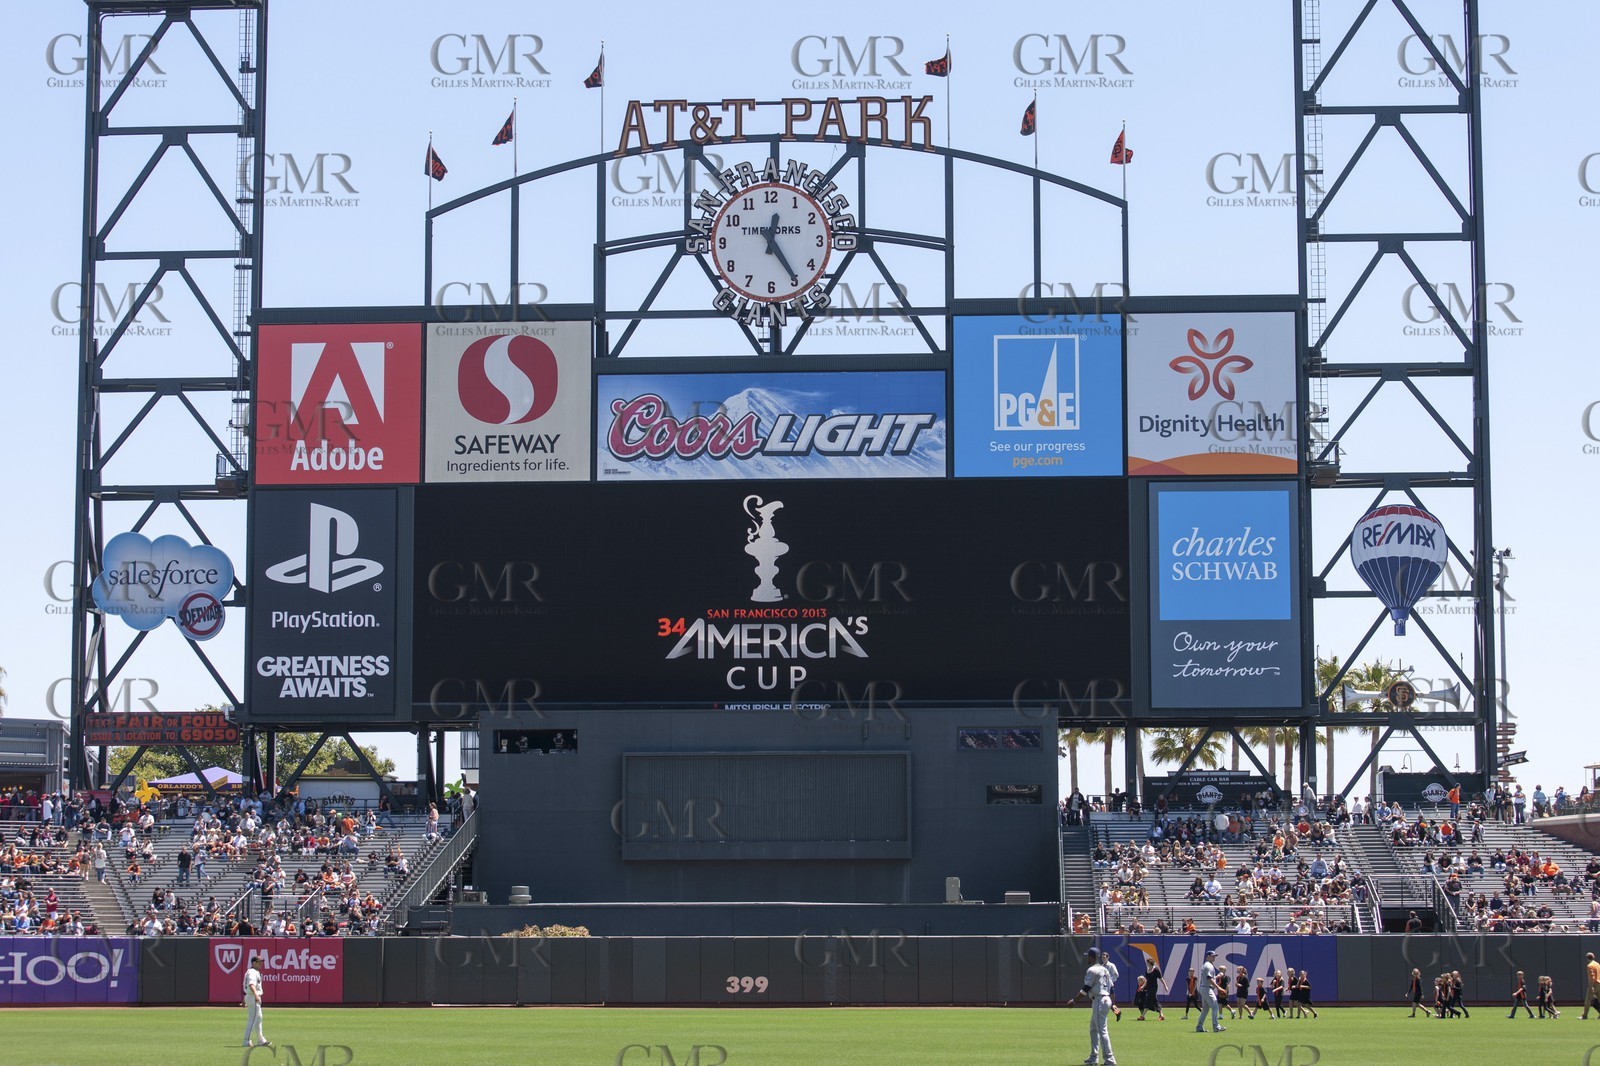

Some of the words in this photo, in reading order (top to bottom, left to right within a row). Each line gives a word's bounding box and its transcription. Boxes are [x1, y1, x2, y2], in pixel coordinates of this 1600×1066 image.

[614, 99, 755, 157] AT&T
[781, 95, 933, 152] PARK
[686, 189, 723, 254] SAN
[719, 157, 857, 251] FRANCISCO
[743, 198, 754, 210] 11
[764, 191, 778, 204] 12
[792, 197, 798, 209] 1
[726, 215, 740, 227] 10
[808, 212, 816, 225] 2
[741, 226, 801, 235] TIMEORKS
[719, 237, 726, 249] 9
[816, 235, 823, 247] 3
[727, 260, 735, 272] 8
[807, 259, 815, 271] 4
[745, 275, 753, 287] 7
[767, 281, 775, 293] 6
[712, 284, 831, 327] GIANTS
[1000, 393, 1074, 427] PG&E
[607, 393, 766, 460] Coors
[762, 412, 937, 457] LIGHT
[1139, 414, 1212, 438] Dignity
[1218, 413, 1284, 432] Health
[454, 433, 561, 455] SAFEWAY
[990, 441, 1010, 452] See
[1013, 443, 1032, 452] our
[1035, 442, 1086, 455] progress
[290, 439, 384, 471] Adobe
[1012, 455, 1063, 469] pge.com
[446, 459, 520, 475] Ingredients
[523, 458, 541, 471] for
[545, 458, 570, 471] life.
[1172, 527, 1277, 557] charles
[1362, 521, 1436, 551] RE/MAX
[109, 560, 218, 599] salesforce
[1172, 561, 1278, 581] SCHWAB
[179, 604, 223, 626] SOFTWARE
[272, 611, 375, 634] PlayStation
[707, 608, 731, 619] SAN
[734, 608, 798, 619] FRANCISCO
[802, 608, 827, 618] 2013
[657, 617, 686, 637] 34
[1173, 631, 1221, 652] Own
[1223, 640, 1278, 662] your
[256, 655, 389, 677] GREATNESS
[1173, 659, 1280, 677] tomorrow
[726, 666, 807, 690] CUP
[279, 677, 367, 698] AWAITS
[114, 715, 164, 728] FAIR
[167, 718, 178, 727] OR
[181, 715, 228, 728] FOUL
[123, 731, 161, 741] LOCATION
[181, 729, 236, 741] 69050
[322, 795, 355, 806] GIANTS
[247, 948, 337, 970] McAfee
[1128, 942, 1293, 995] VISA
[282, 973, 321, 984] Company
[726, 976, 769, 994] 399
